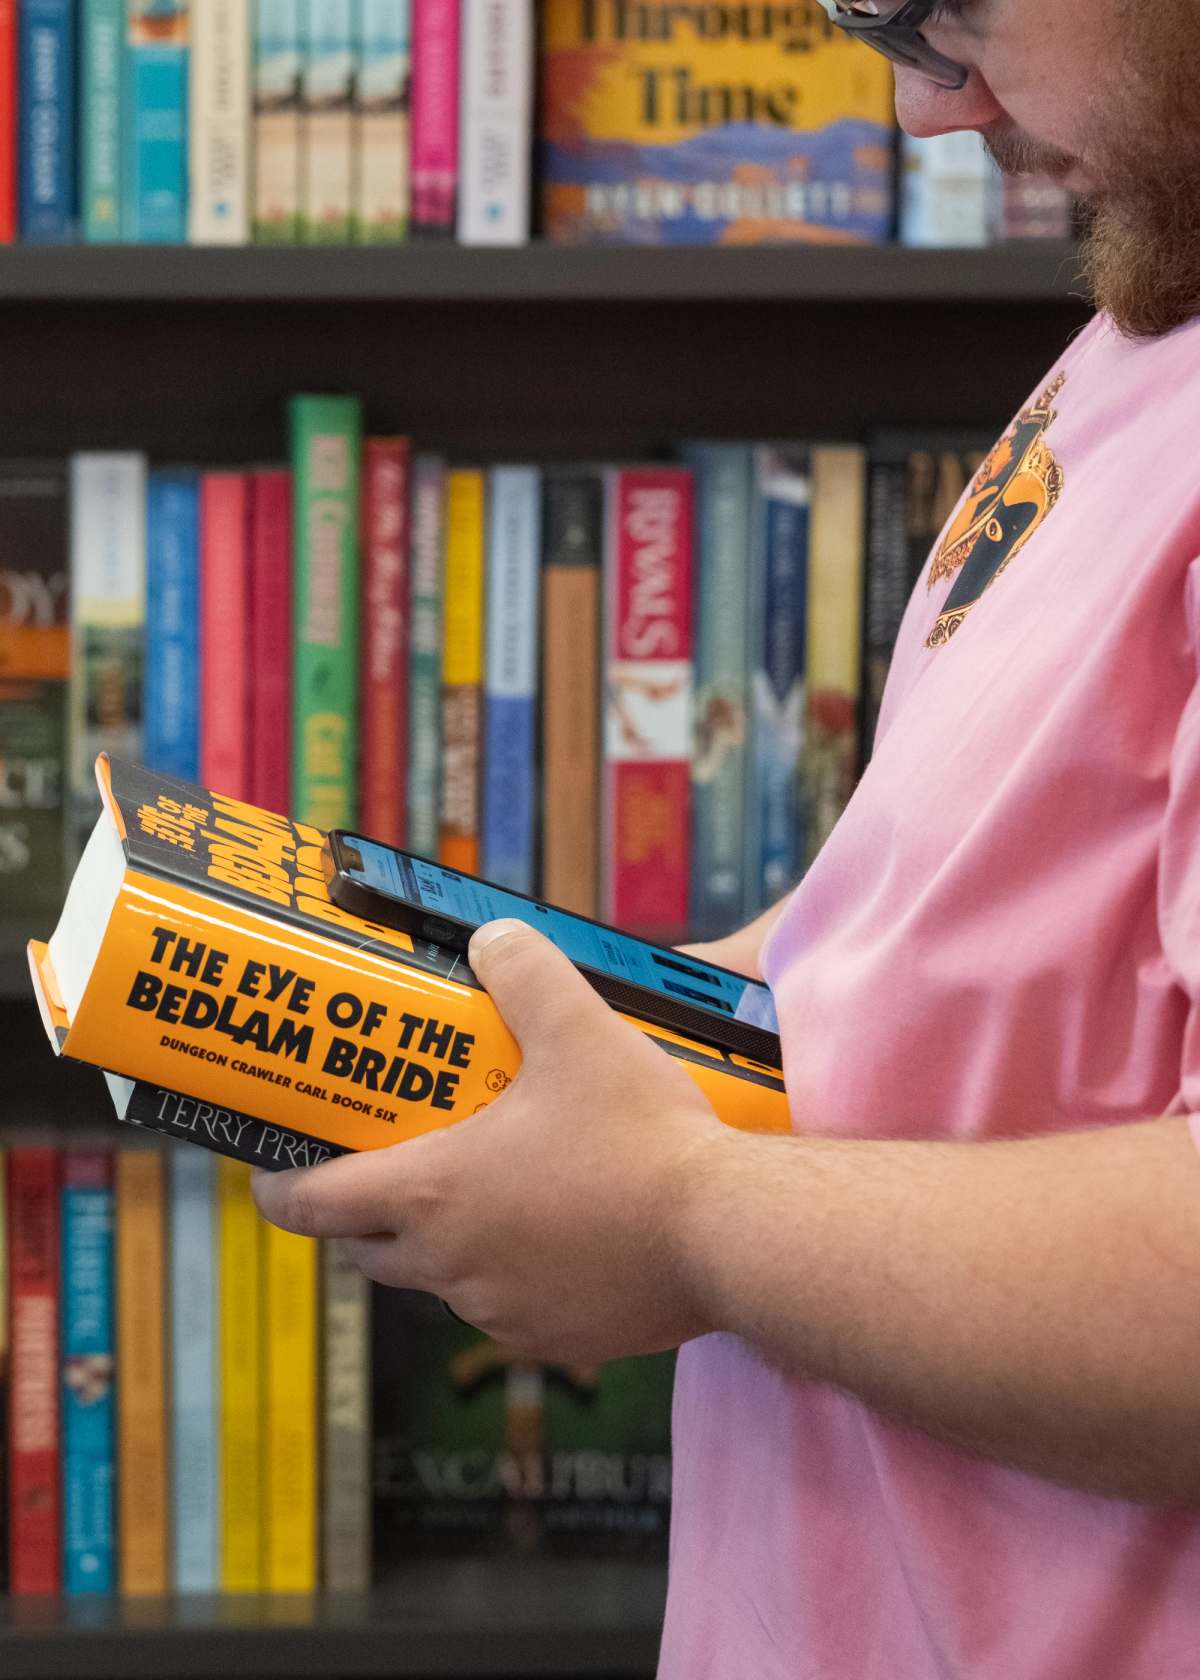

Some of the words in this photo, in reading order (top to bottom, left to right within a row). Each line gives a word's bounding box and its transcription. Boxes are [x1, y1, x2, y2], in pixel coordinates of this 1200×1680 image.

[636, 66, 797, 126] Time
[622, 488, 680, 657] RIVALS
[200, 791, 297, 907] BEDLAM
[126, 970, 315, 1064] BEDLAM
[321, 1037, 460, 1111] BRIDE
[150, 926, 229, 988] THE
[236, 960, 316, 1015] EYE
[326, 992, 388, 1037] OF
[398, 1013, 476, 1069] THE
[157, 1089, 252, 1147] TERRY
[254, 1125, 347, 1169] PRAT
[159, 1035, 228, 1066] DUNGEON
[231, 1060, 292, 1088] CRAWLER
[294, 1081, 328, 1100] CARL
[331, 1093, 373, 1115] BOOK
[374, 1108, 398, 1124] SIX
